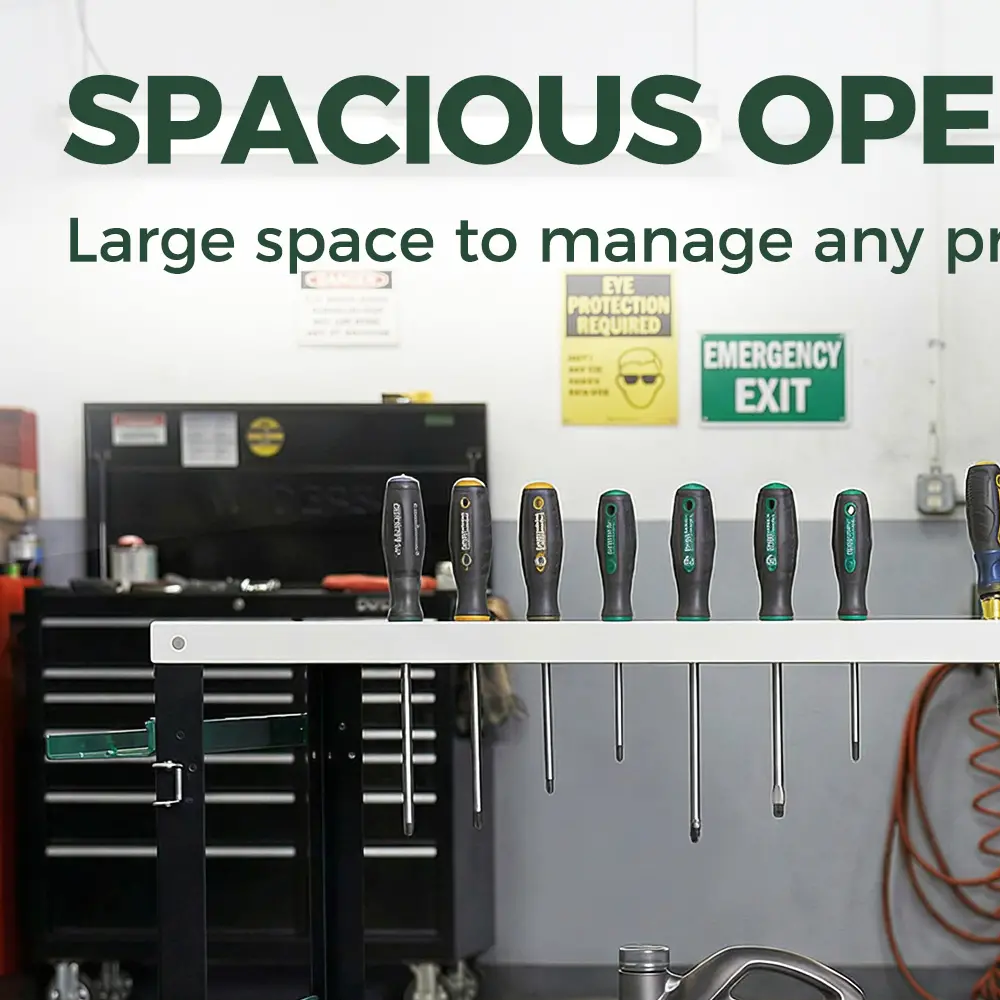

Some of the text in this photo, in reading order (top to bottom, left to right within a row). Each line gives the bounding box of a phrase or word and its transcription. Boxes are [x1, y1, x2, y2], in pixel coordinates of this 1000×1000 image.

[602, 275, 636, 295] EYE
[567, 295, 671, 315] PROTECTION
[576, 315, 663, 336] REQUIRED
[703, 340, 842, 370] EMERGENCY
[734, 376, 813, 414] EXIT
